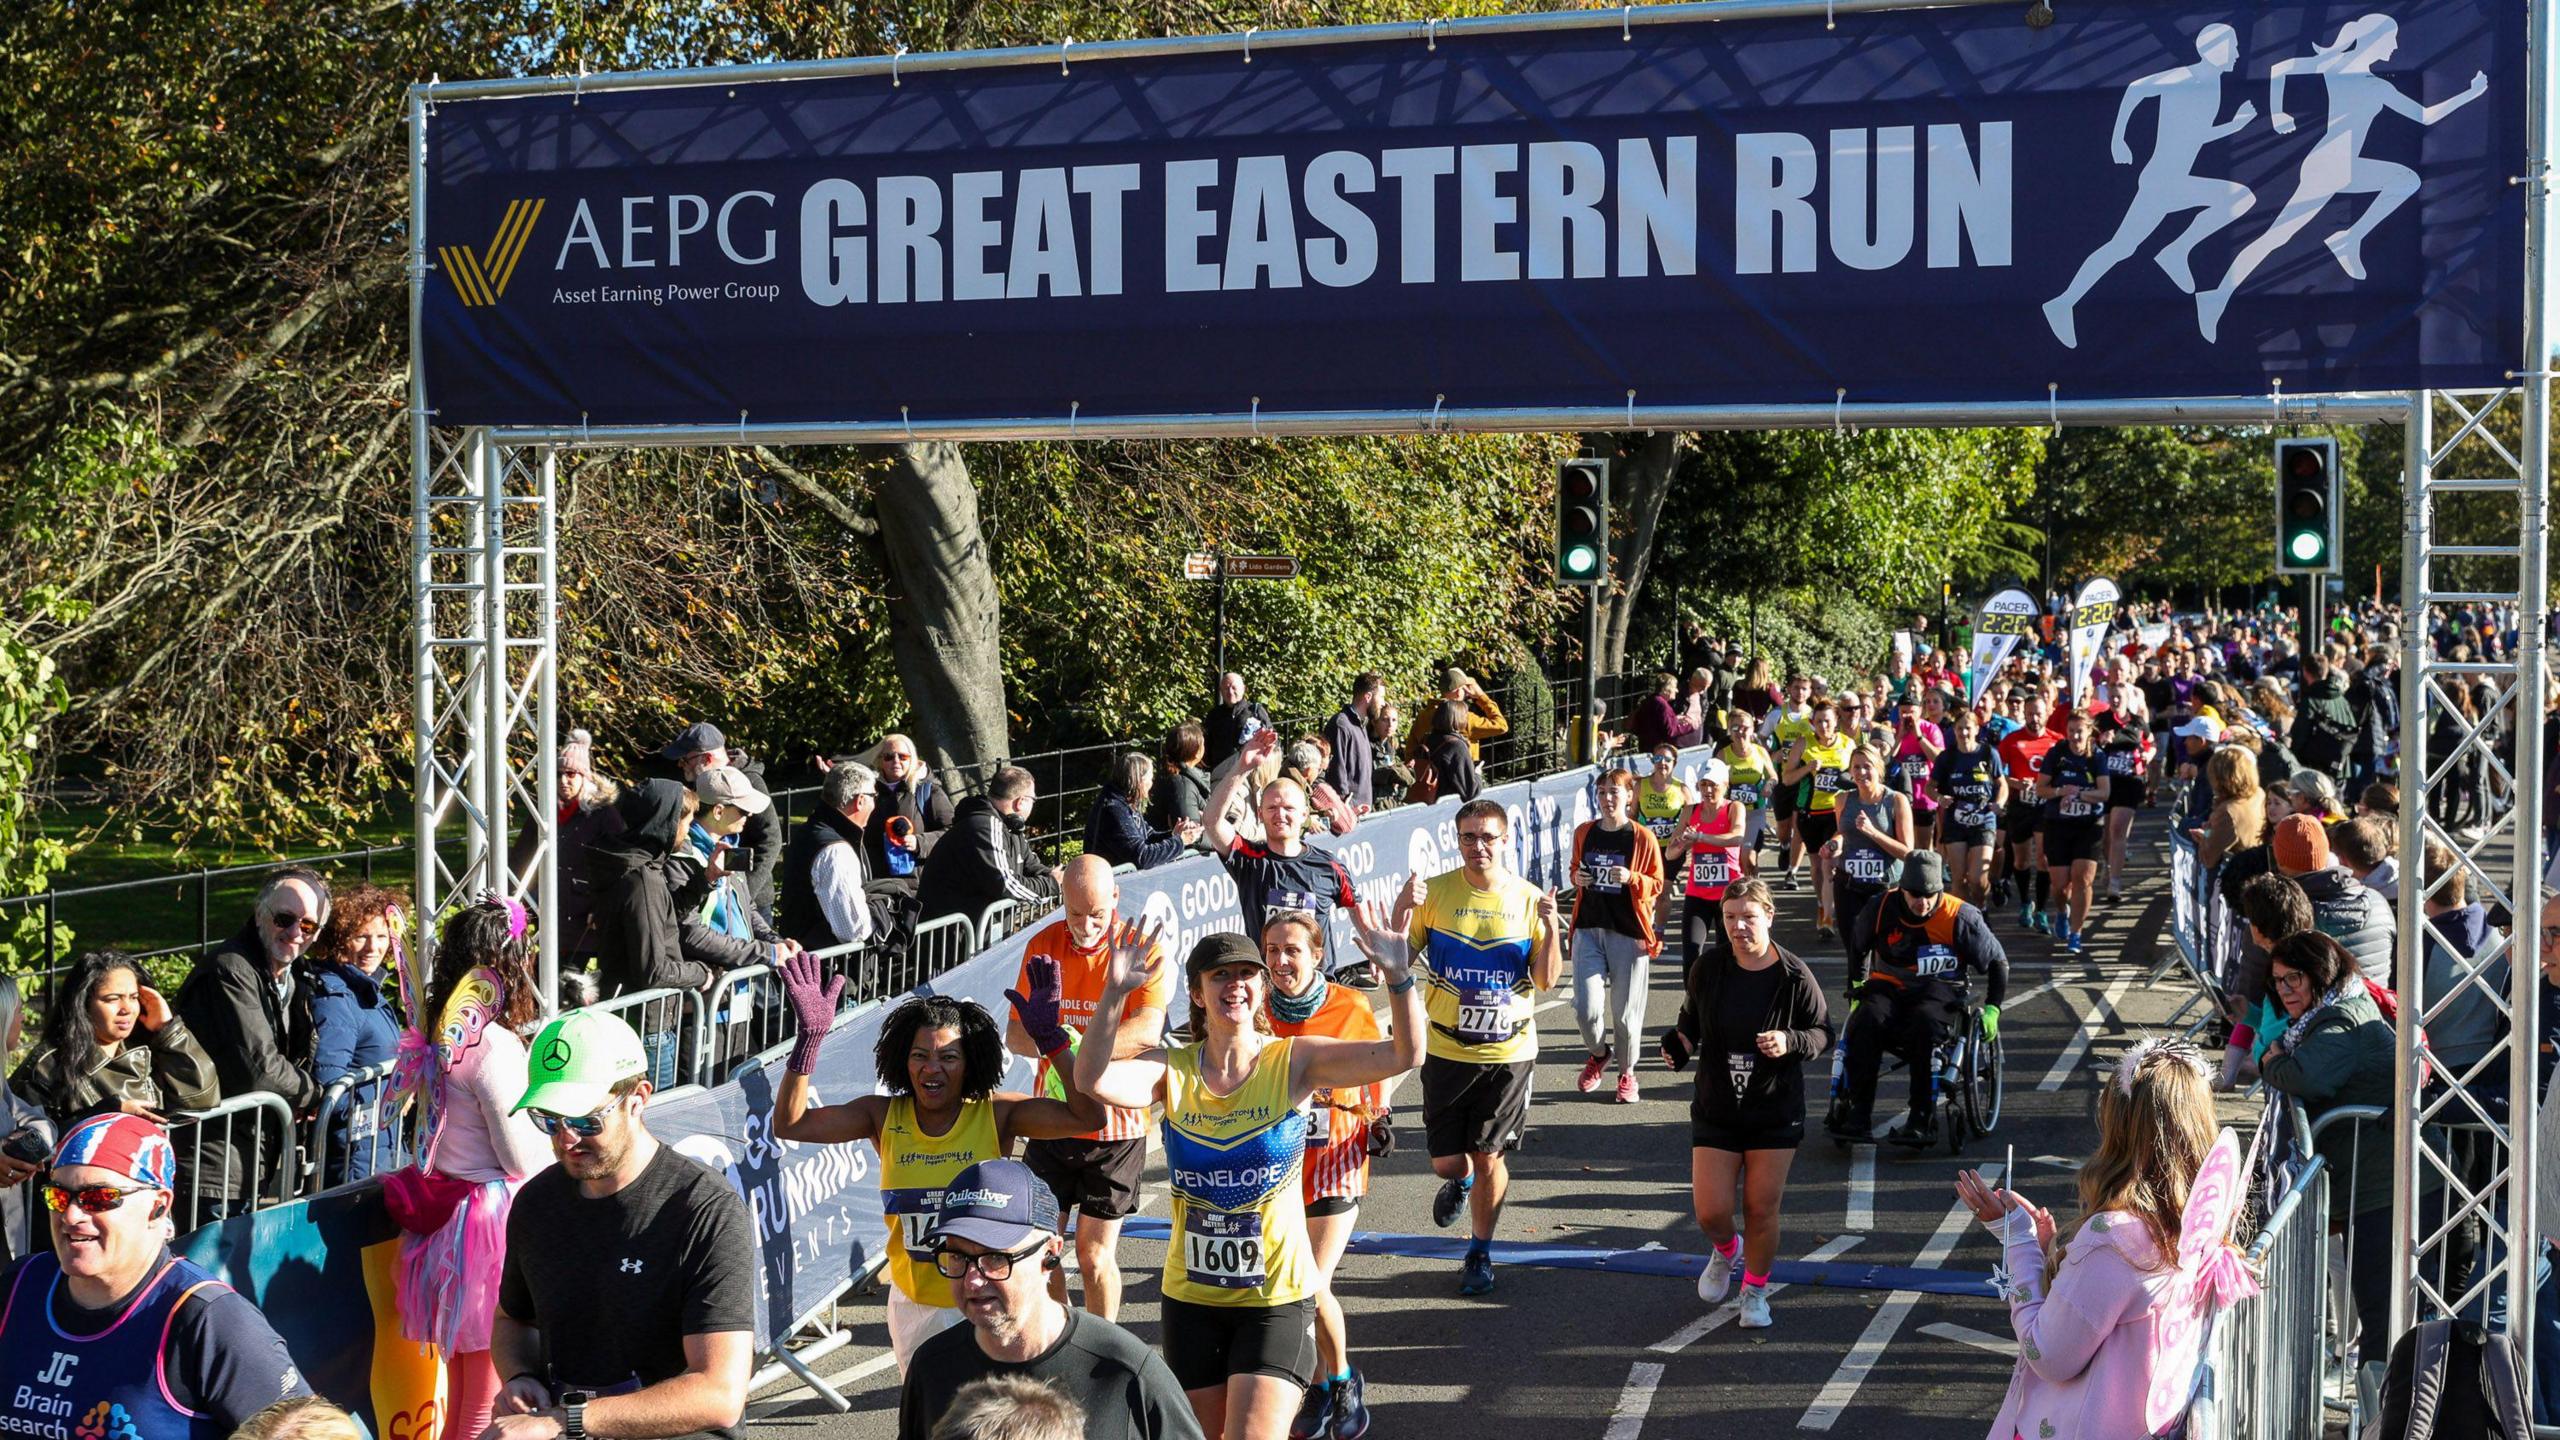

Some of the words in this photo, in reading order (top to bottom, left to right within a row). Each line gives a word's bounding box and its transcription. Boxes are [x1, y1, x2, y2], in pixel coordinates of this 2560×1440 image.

[800, 163, 1141, 307] GREAT
[1165, 136, 1697, 293] EASTERN
[1736, 120, 2013, 275] RUN
[554, 190, 777, 271] AEPG
[552, 287, 597, 304] Asset
[600, 284, 664, 306] Earning
[667, 282, 721, 301] Power
[723, 281, 781, 302] Group
[1994, 601, 2030, 613] PACER
[2084, 590, 2113, 604] PACER
[1982, 613, 2028, 634] 2:20
[2077, 602, 2113, 628] 2:20
[1695, 864, 1726, 881] 3091
[1847, 861, 1882, 877] 3104
[1181, 872, 1239, 920] GOOD
[1444, 966, 1516, 985] MATTHEW
[1059, 999, 1081, 1010] NDLE
[1174, 1163, 1283, 1188] PENELOPE
[750, 1139, 868, 1249] RUNNING
[945, 1188, 1014, 1207] Quiksilver
[1207, 1213, 1226, 1222] GREAT
[1213, 1227, 1227, 1235] RUN
[759, 1205, 852, 1301] EVENTS
[1191, 1235, 1259, 1273] 1609
[37, 1351, 80, 1387] JC
[13, 1384, 74, 1418] Brain
